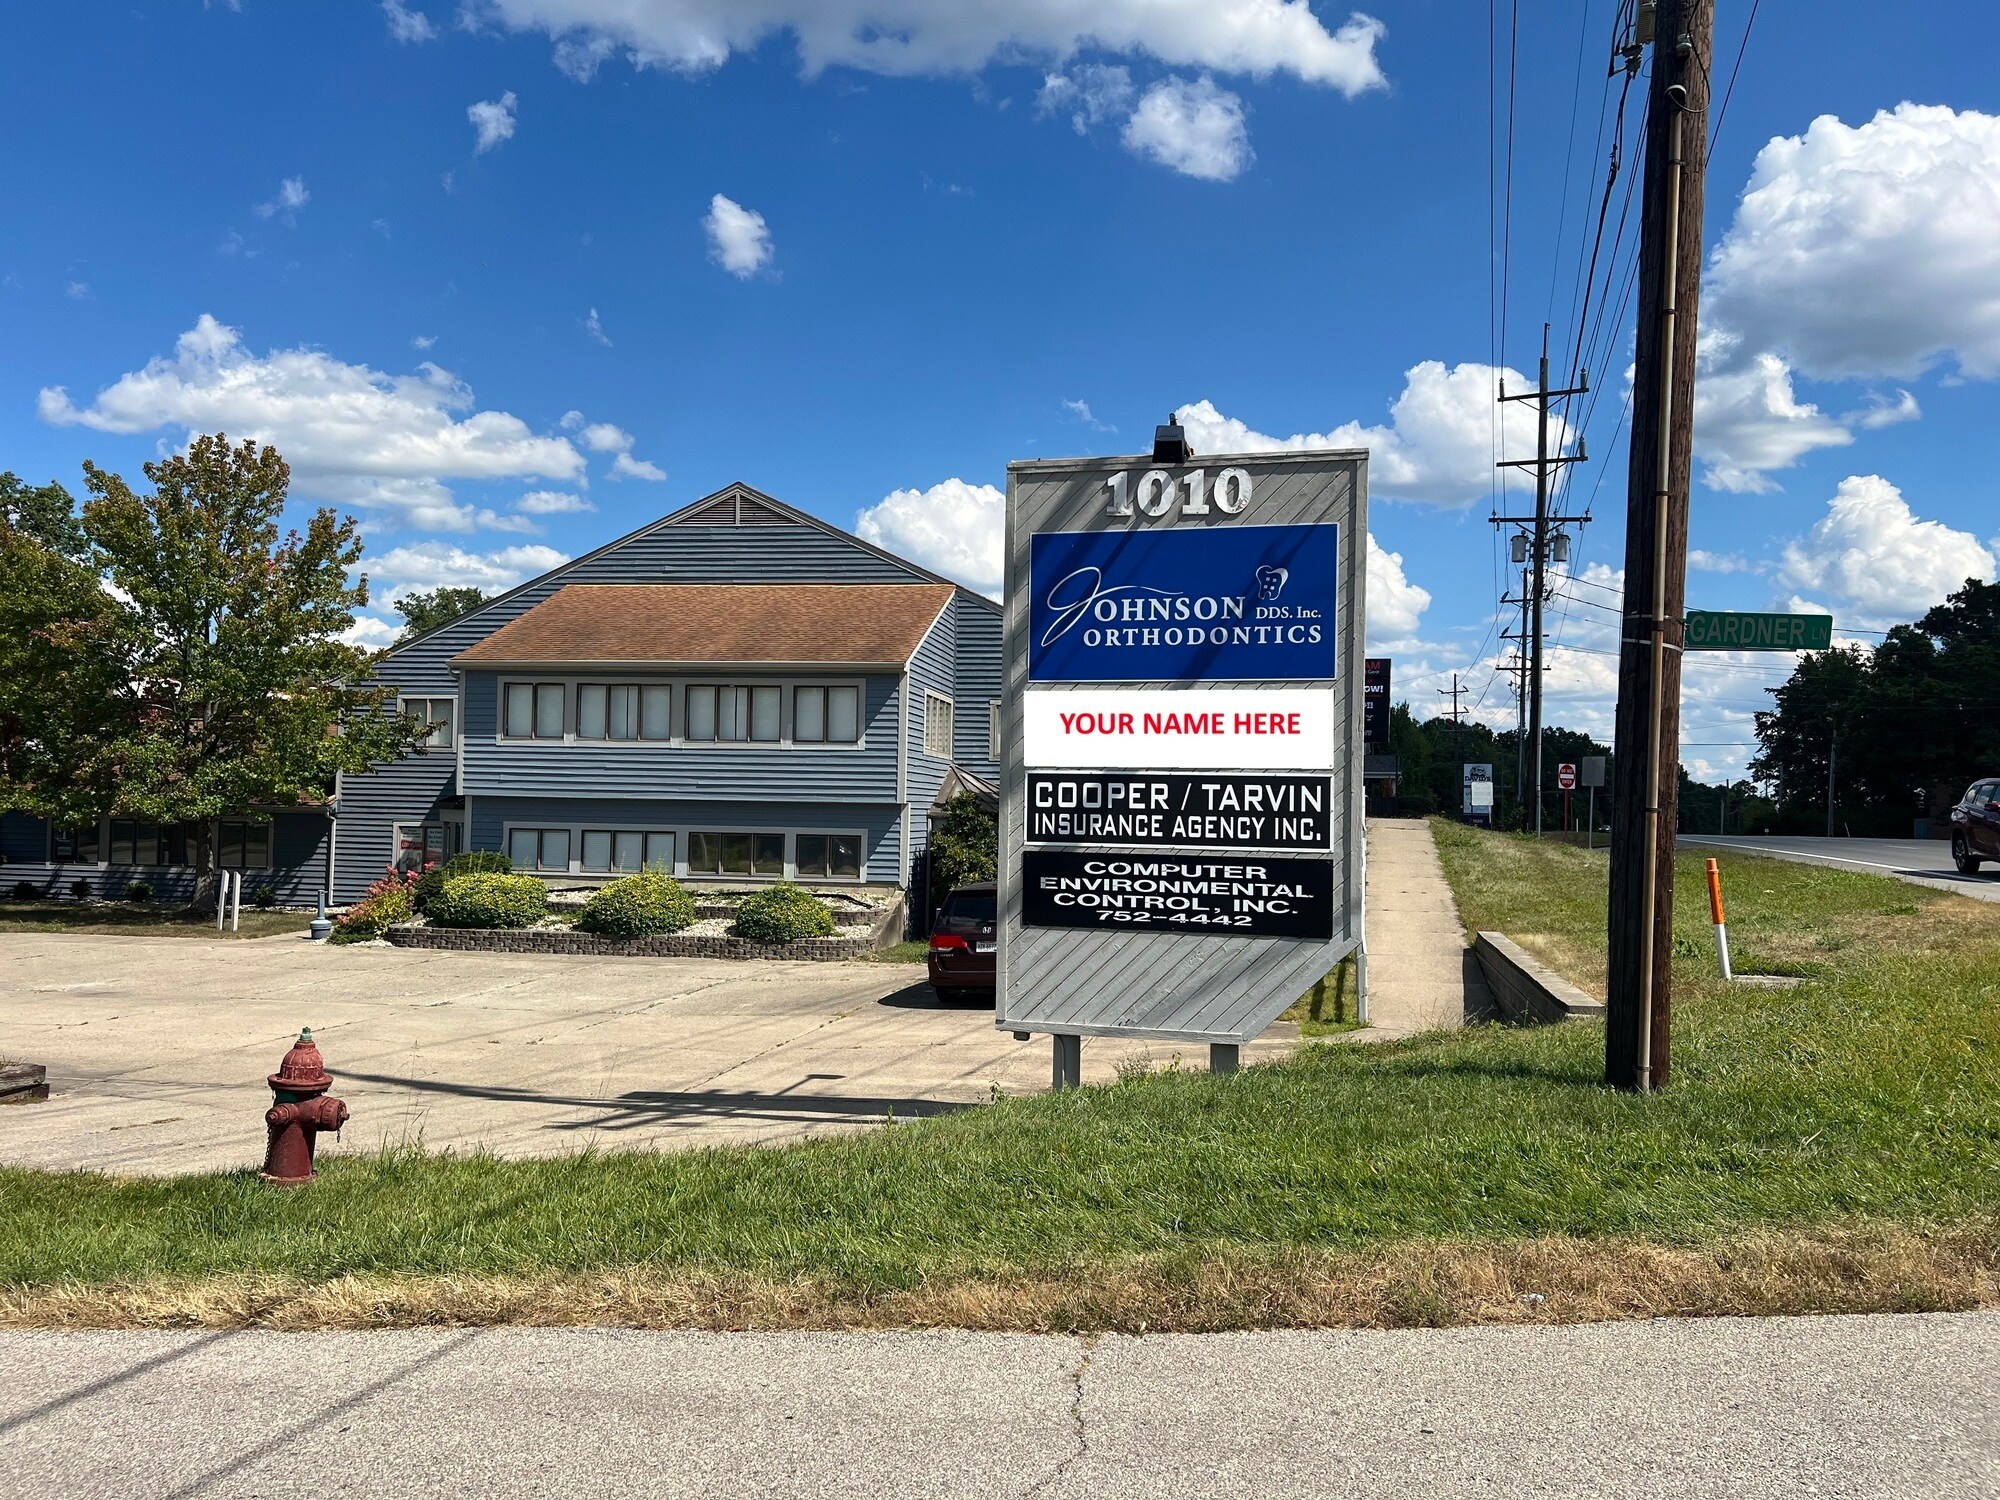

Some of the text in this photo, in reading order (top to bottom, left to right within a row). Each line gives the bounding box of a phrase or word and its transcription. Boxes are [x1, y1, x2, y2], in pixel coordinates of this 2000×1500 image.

[1106, 467, 1253, 517] 1010
[1041, 566, 1322, 647] JOHNSON DDS. Inc.
[1083, 625, 1322, 647] ORTHODONTICS
[1689, 615, 1828, 645] GARDNER LN
[1060, 713, 1301, 735] YOUR NAME HERE
[1035, 782, 1169, 810] COOPER
[1202, 784, 1322, 813] TARVIN
[1035, 812, 1321, 841] INSURANCE AGENCY INC.
[1084, 861, 1267, 879] COMPUTER
[1040, 877, 1314, 898] ENVIRONMENTAL
[1053, 893, 1298, 914] CONTROL, INC.
[1096, 910, 1252, 927] 752-4442
